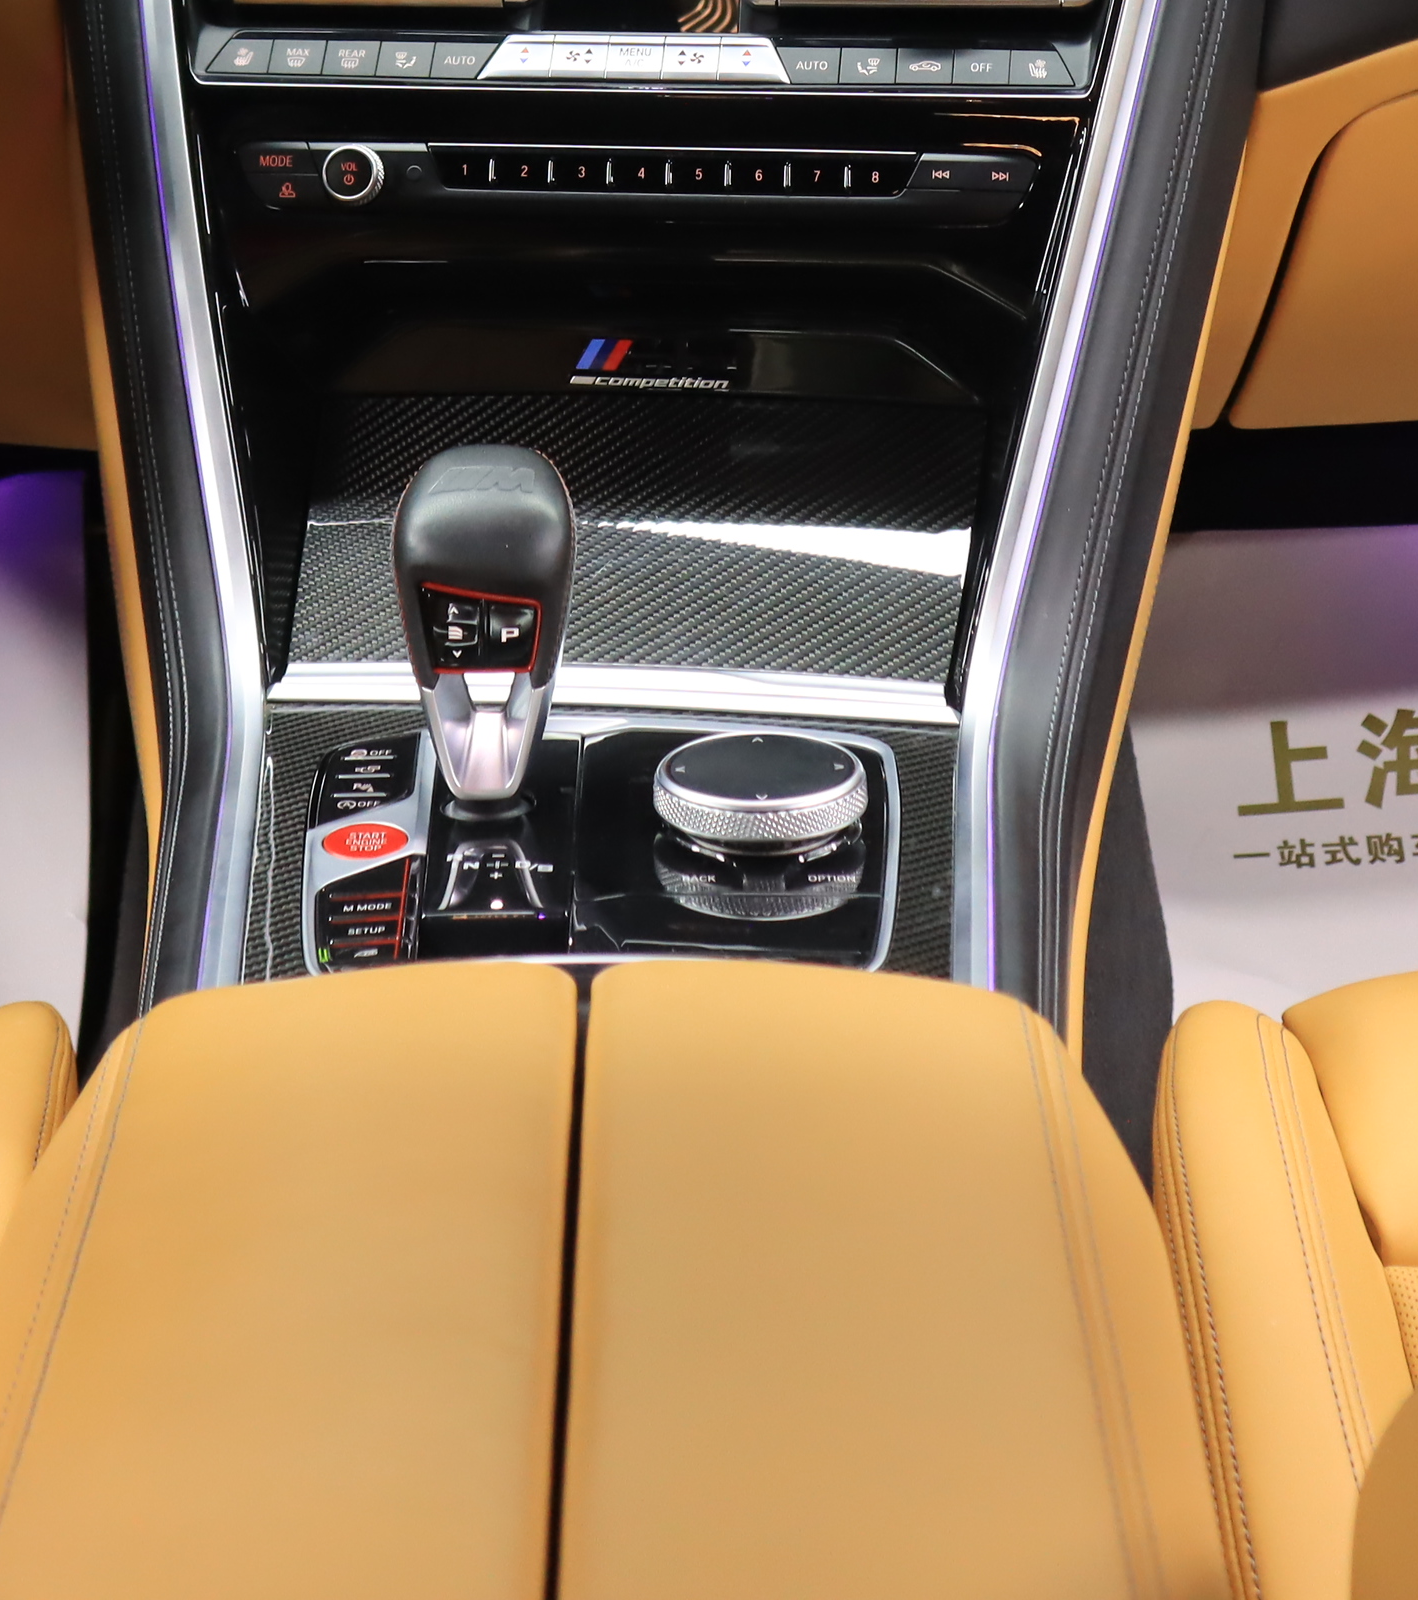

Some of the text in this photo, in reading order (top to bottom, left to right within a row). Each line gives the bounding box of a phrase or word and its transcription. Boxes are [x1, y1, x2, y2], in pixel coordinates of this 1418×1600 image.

[286, 47, 310, 57] MAX
[338, 48, 366, 58] REAR
[619, 47, 652, 58] MENU
[444, 55, 476, 65] AUTO
[795, 60, 828, 71] AUTO
[970, 62, 993, 73] OFF
[259, 155, 293, 168] MODE
[340, 162, 358, 172] VOL
[520, 165, 529, 177] 2
[578, 166, 586, 178] 3
[637, 167, 645, 179] 4
[695, 168, 703, 180] 5
[755, 169, 763, 181] 6
[813, 170, 821, 182] 7
[871, 171, 880, 183] 8
[594, 376, 730, 389] competition
[501, 626, 520, 643] P
[349, 831, 387, 839] START
[345, 838, 388, 846] ENGINE
[681, 874, 717, 883] BACK
[807, 874, 856, 884] OPTION
[342, 902, 392, 913] M MODE
[347, 925, 386, 936] SETUP
